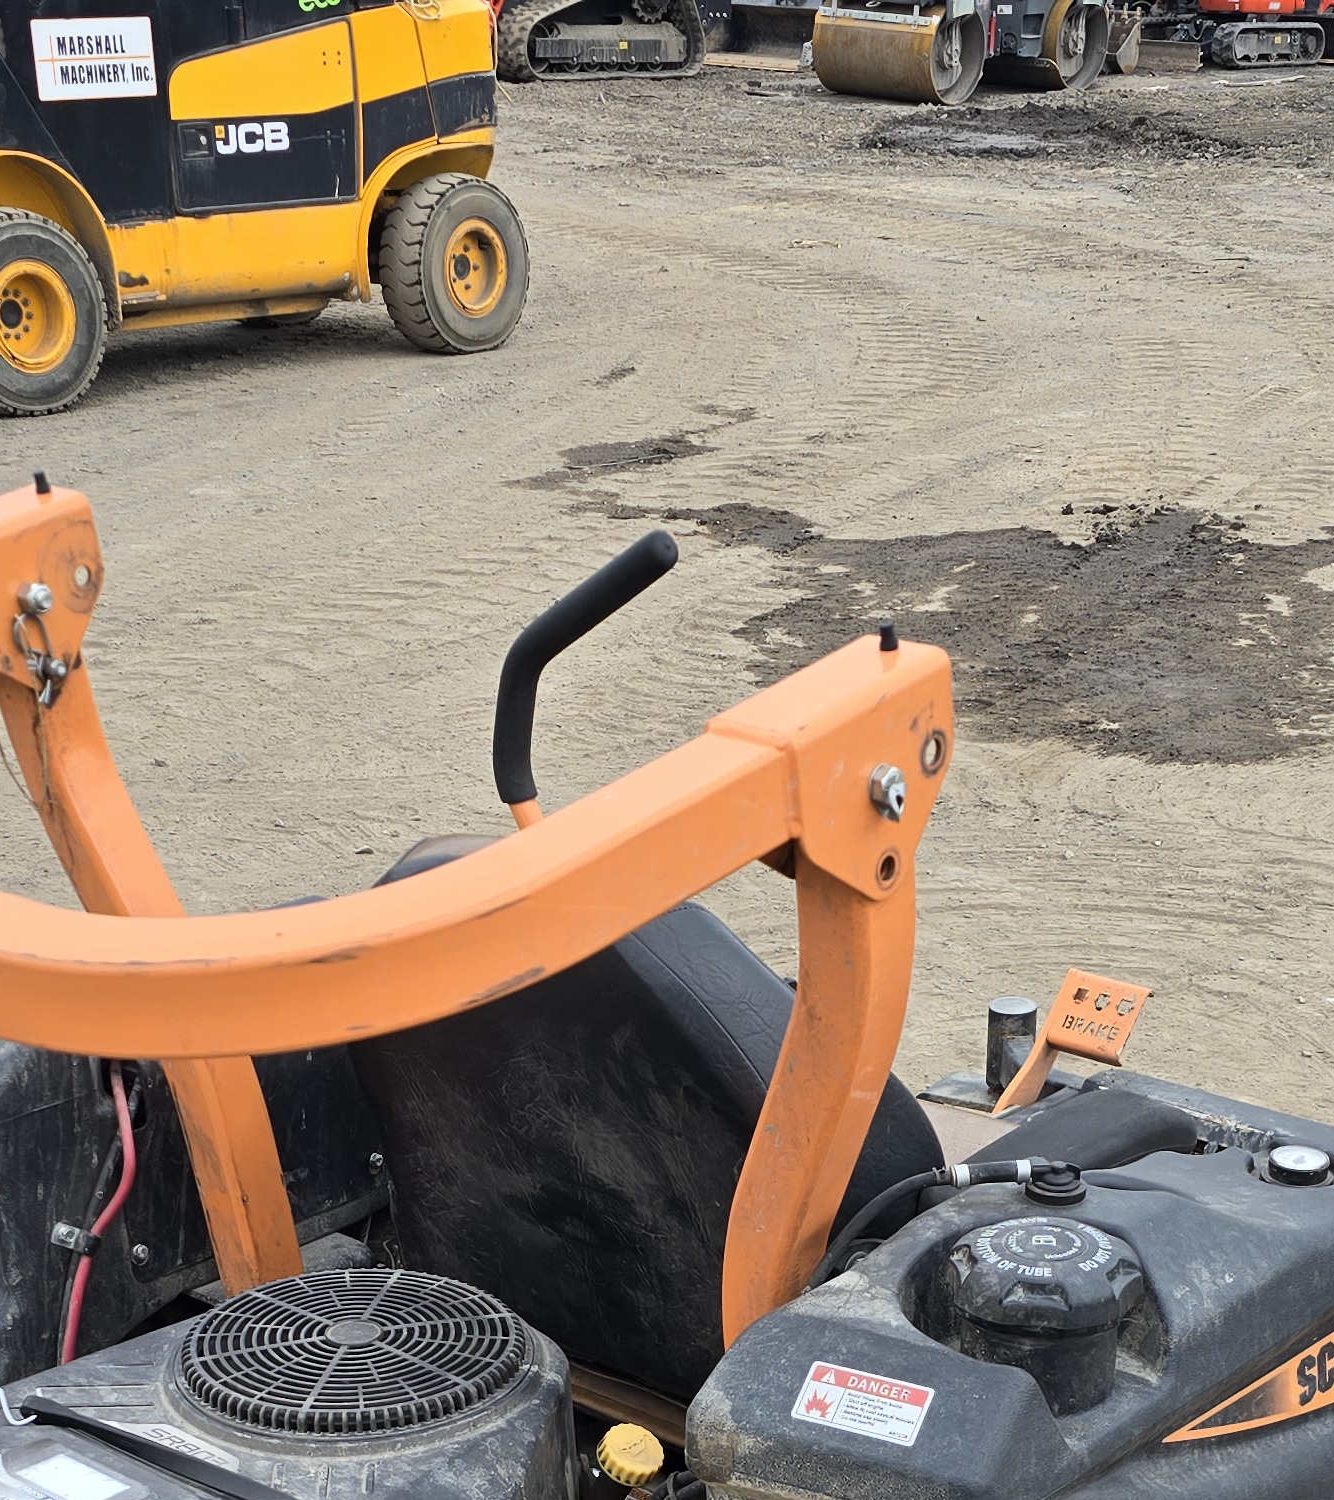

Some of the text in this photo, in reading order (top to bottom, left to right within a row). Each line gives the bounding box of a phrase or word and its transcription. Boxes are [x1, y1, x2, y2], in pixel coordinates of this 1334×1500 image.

[57, 35, 126, 56] MARSHALL
[60, 63, 154, 85] MACHINERY, Inc.
[216, 122, 289, 154] JCB
[1062, 1015, 1119, 1040] BRAKE
[997, 1260, 1017, 1270] OF
[1017, 1265, 1052, 1277] TUBE
[1078, 1260, 1098, 1271] DO
[1092, 1248, 1112, 1264] NOT
[847, 1375, 911, 1401] DANGER
